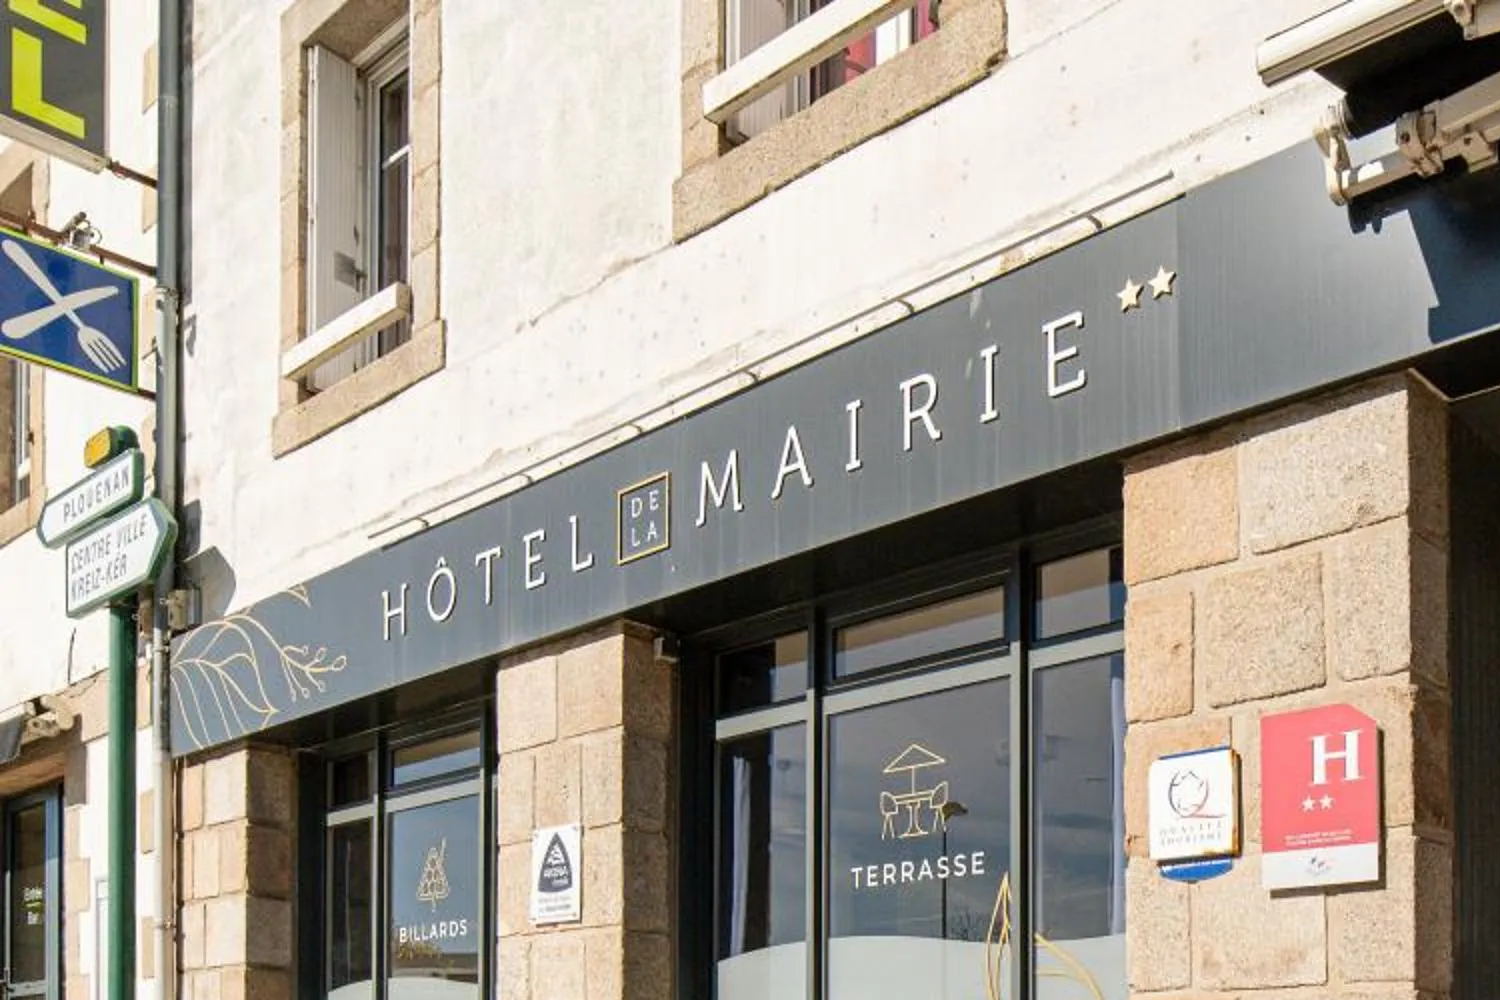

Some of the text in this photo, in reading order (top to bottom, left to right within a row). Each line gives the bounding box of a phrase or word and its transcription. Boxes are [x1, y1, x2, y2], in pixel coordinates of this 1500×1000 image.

[63, 466, 130, 523] PLOUENAN
[382, 310, 1087, 642] HÔTEL DE LA MAIRIE
[71, 513, 148, 574] CENTRE VILLE
[1311, 728, 1366, 785] H
[850, 850, 986, 889] TERRASSE
[399, 919, 468, 944] BILLARDS
